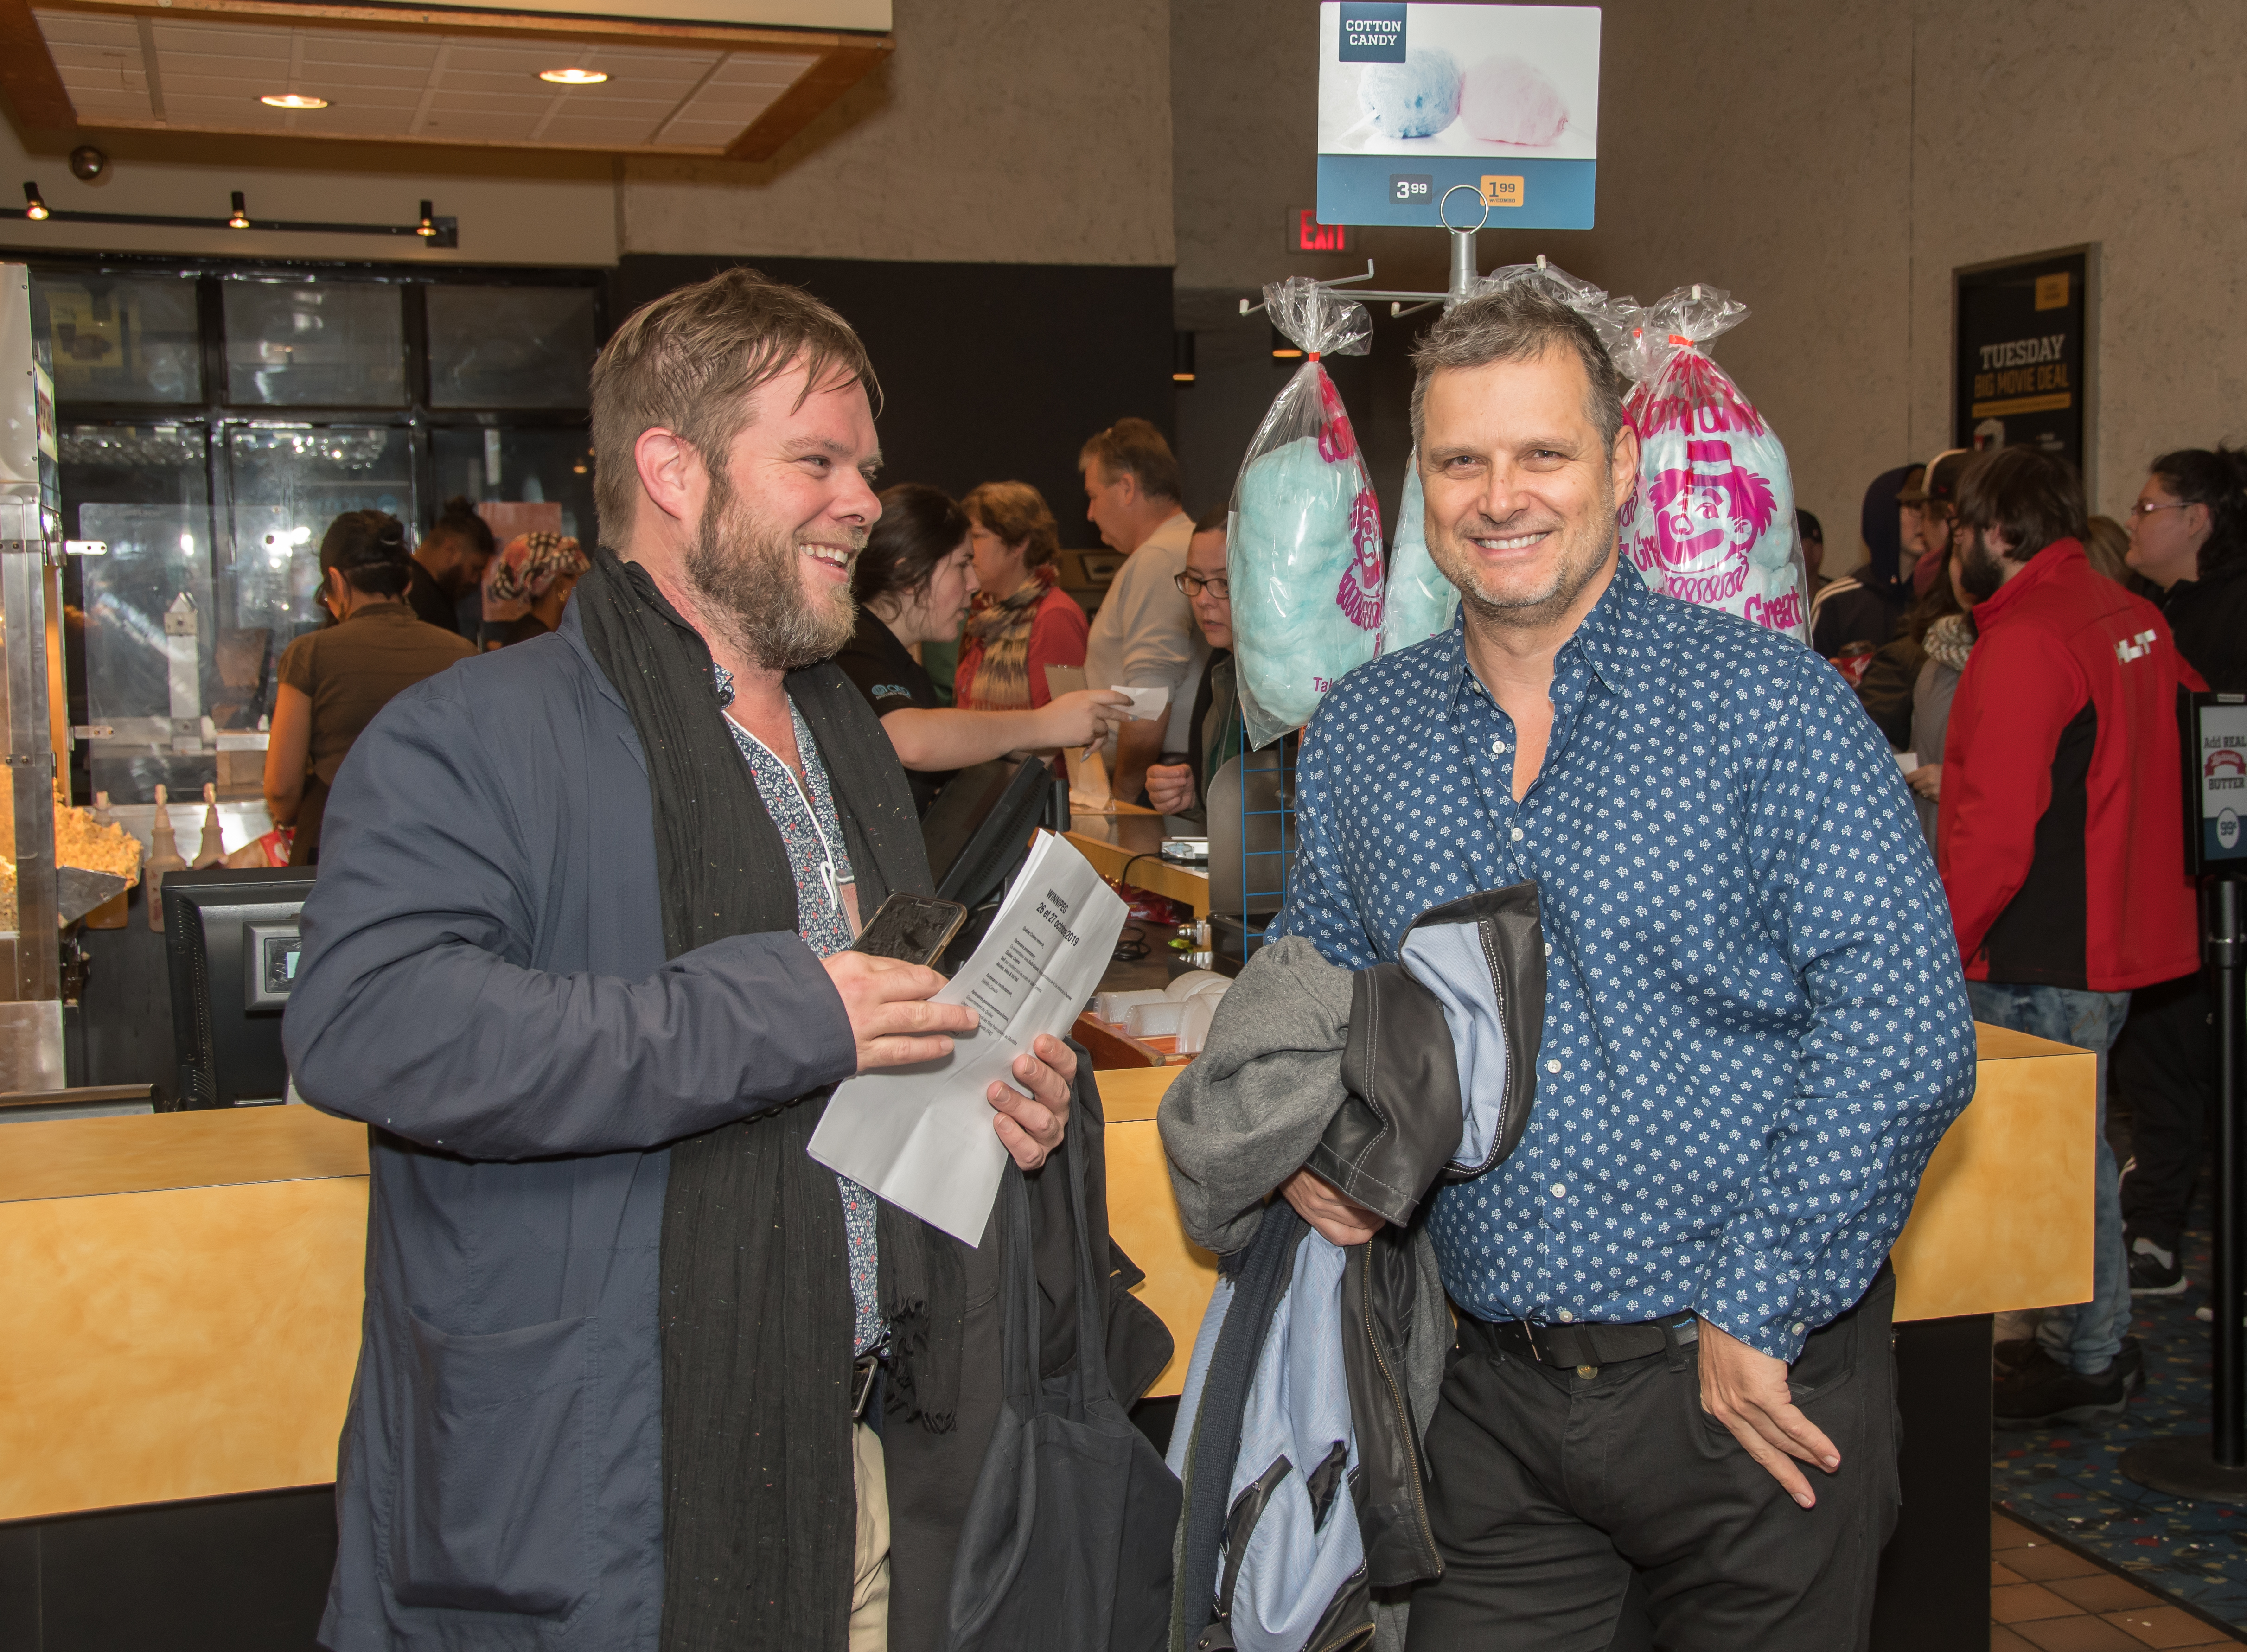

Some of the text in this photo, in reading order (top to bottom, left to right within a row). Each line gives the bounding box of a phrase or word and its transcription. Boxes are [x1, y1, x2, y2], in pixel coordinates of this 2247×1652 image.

[1346, 20, 1401, 32] COTTON
[1349, 33, 1397, 46] CANDY
[1979, 333, 2065, 370] TUESDAY
[1974, 363, 2070, 399] BIG MOVIE DEAL
[1744, 586, 1803, 630] Great
[2223, 735, 2247, 748] REAL
[2209, 777, 2244, 790] BUTTER
[843, 885, 857, 902] CINÉ
[1046, 888, 1069, 914] WINNIPEG
[1064, 930, 1079, 947] 2019
